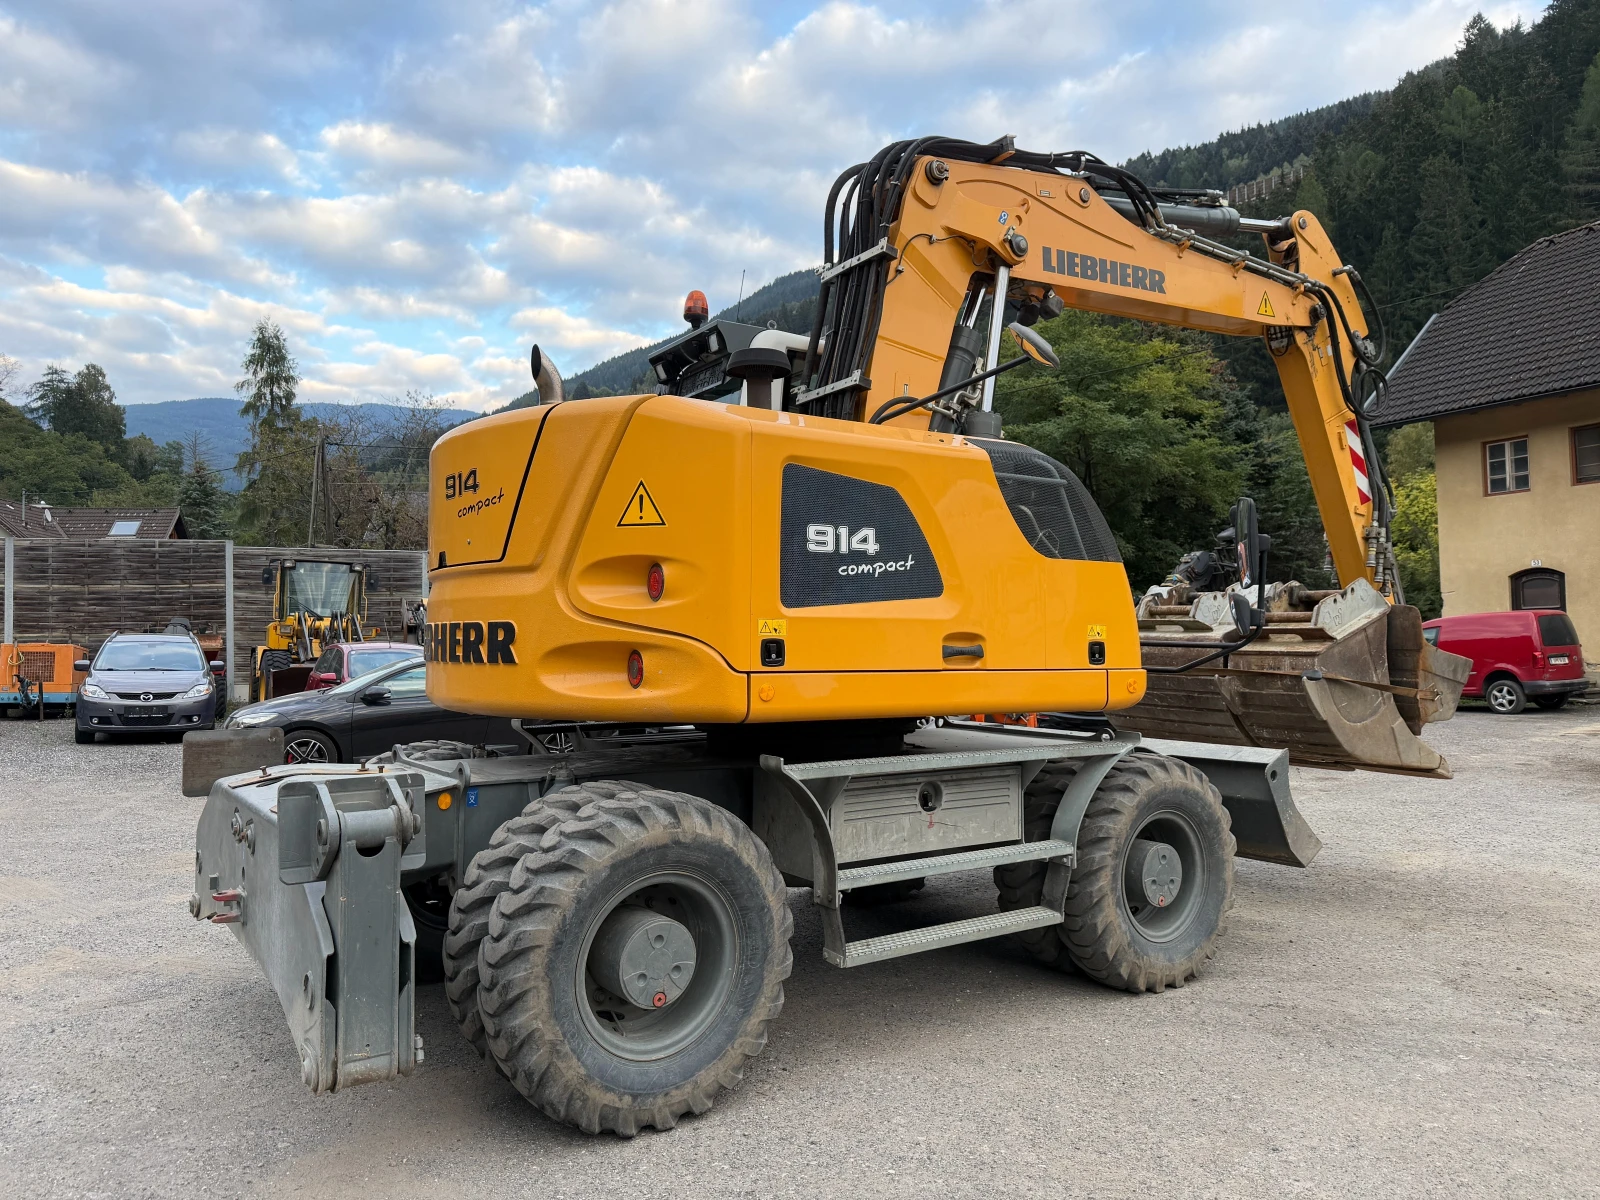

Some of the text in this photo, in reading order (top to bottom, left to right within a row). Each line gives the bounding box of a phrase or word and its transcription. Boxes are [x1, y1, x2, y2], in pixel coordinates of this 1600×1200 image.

[1042, 245, 1166, 295] LIEBHERR
[445, 467, 480, 501] 914
[457, 486, 505, 518] compact
[806, 523, 880, 556] 914
[838, 553, 915, 578] compact
[424, 621, 518, 664] BHERR
